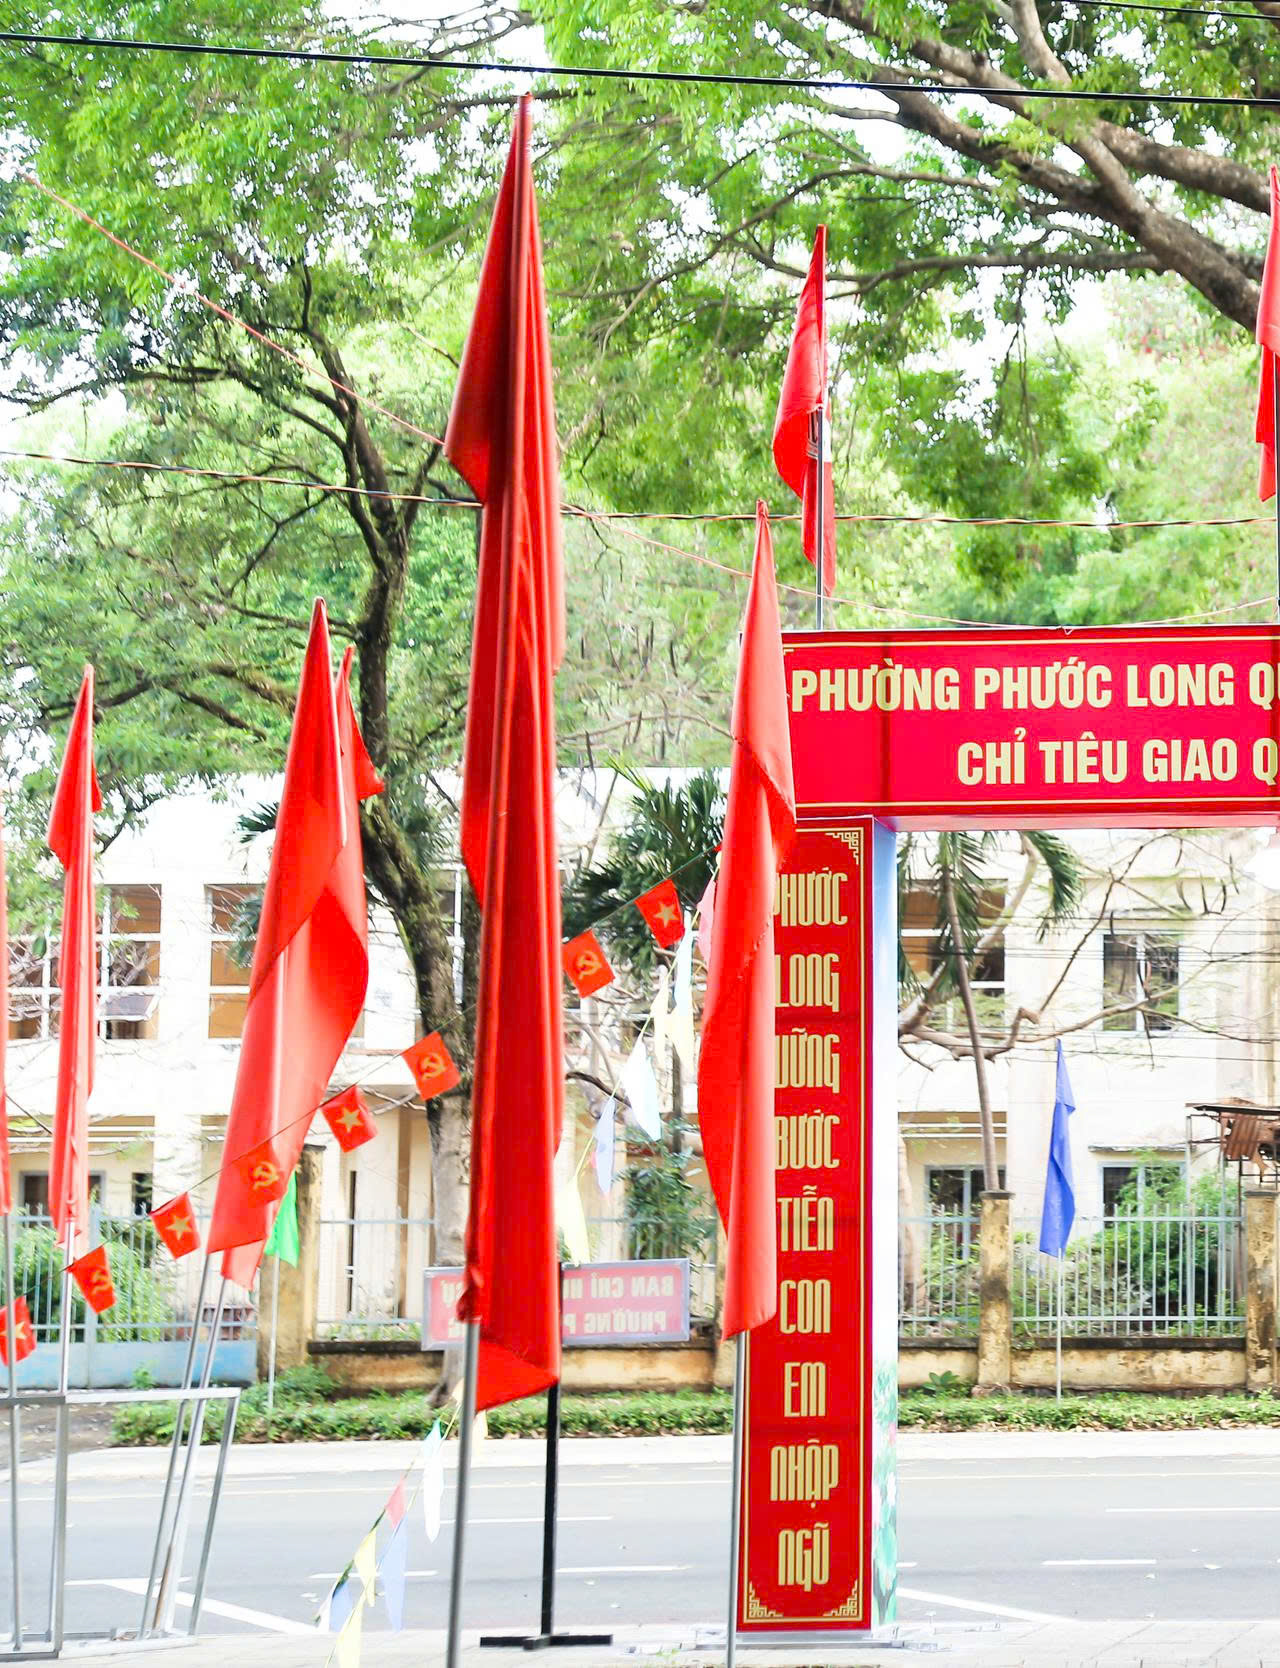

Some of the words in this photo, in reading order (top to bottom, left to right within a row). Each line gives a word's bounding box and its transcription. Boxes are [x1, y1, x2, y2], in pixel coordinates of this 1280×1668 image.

[791, 658, 960, 712] PHƯỜNG
[974, 656, 1113, 710] PHƯỚC
[1126, 662, 1235, 708] LONG
[957, 727, 1027, 786] CHỈ
[1038, 731, 1128, 784] TIÊU
[1142, 737, 1238, 783] GIAO
[775, 953, 840, 1013] LONG
[774, 1109, 840, 1170] BƯỚC
[777, 1185, 834, 1252] TIỄN
[780, 1279, 831, 1334] CON
[783, 1362, 826, 1417] EM
[770, 1439, 839, 1509] NHẬP
[778, 1523, 830, 1592] NGŨ
